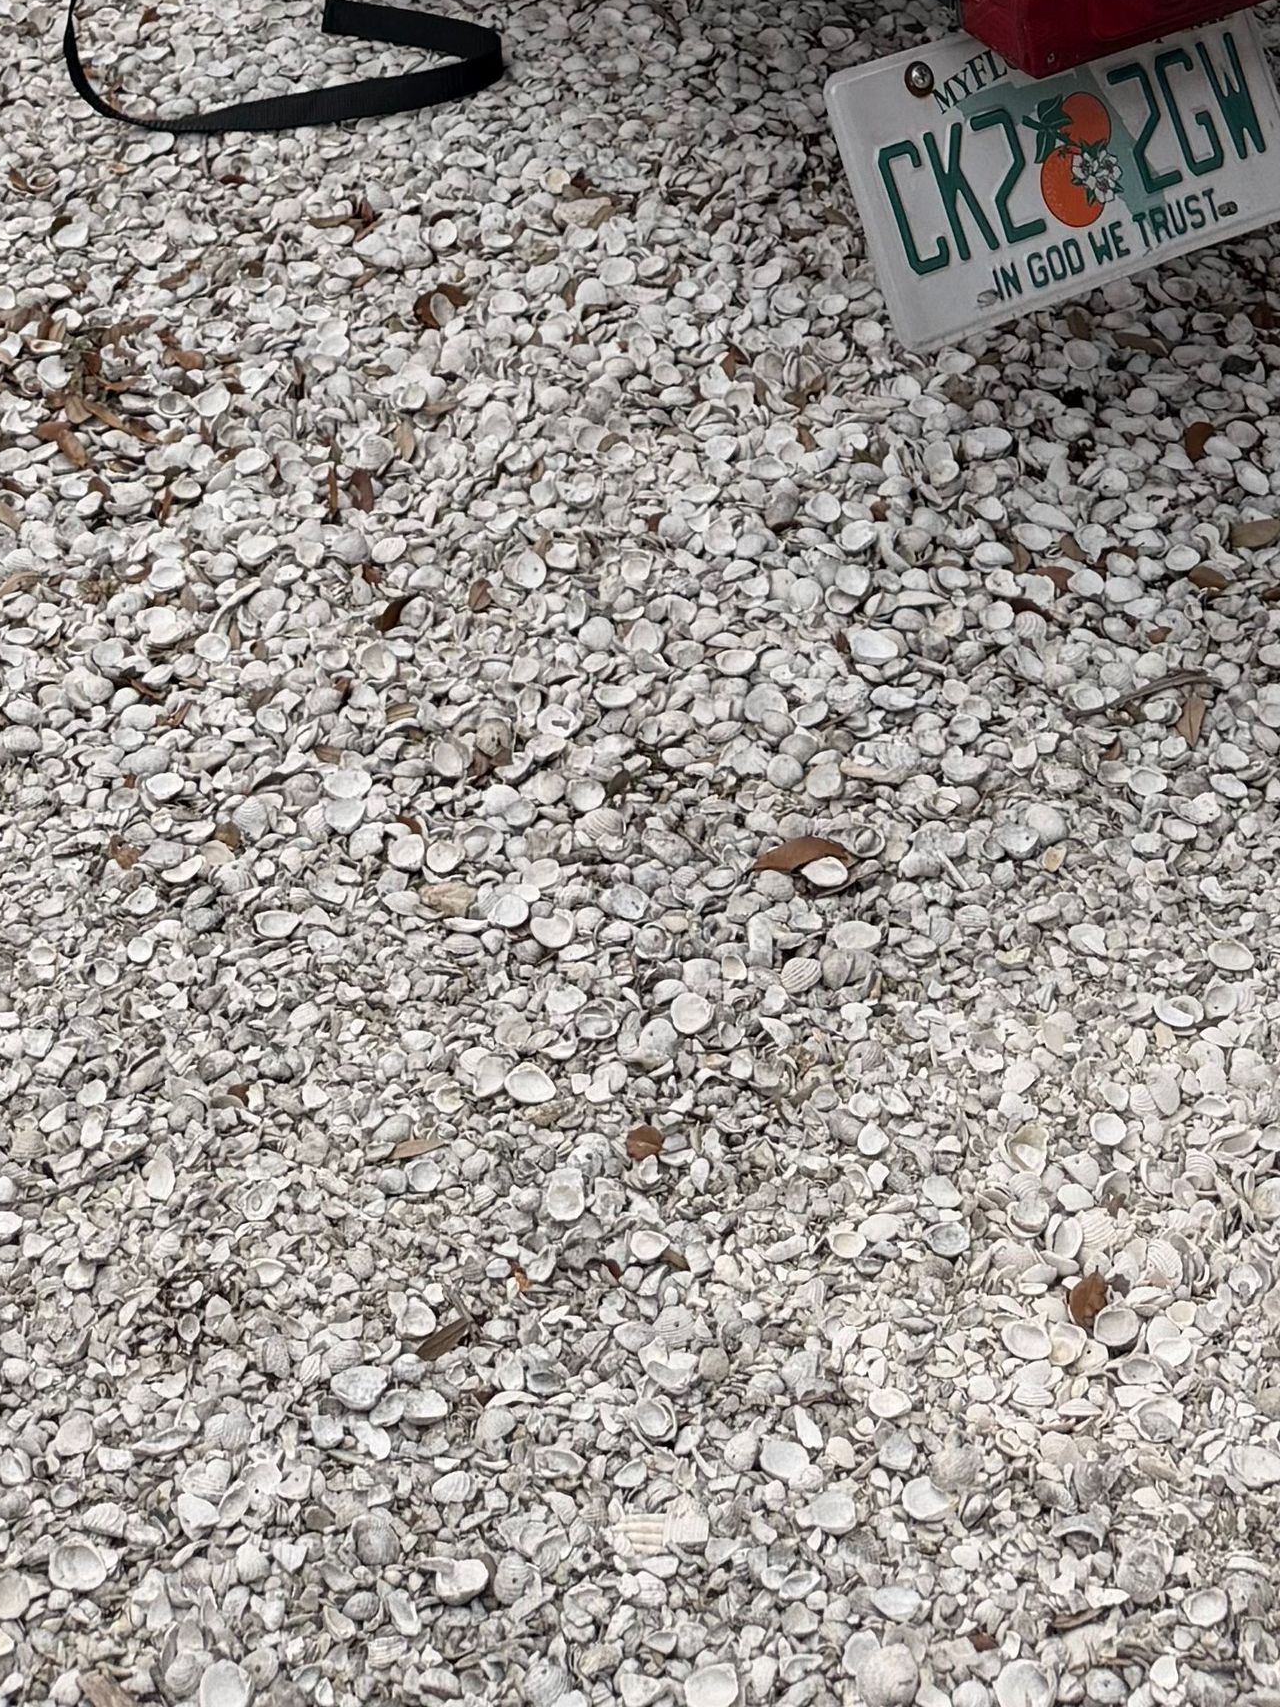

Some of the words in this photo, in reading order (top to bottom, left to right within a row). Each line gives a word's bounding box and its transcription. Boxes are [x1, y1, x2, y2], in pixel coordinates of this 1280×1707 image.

[878, 108, 1048, 276] CK2
[1106, 31, 1267, 195] 2GW
[991, 261, 1024, 302] IN
[1026, 237, 1086, 288] GOD
[1087, 221, 1131, 266] WE
[1132, 187, 1221, 249] TRUST
